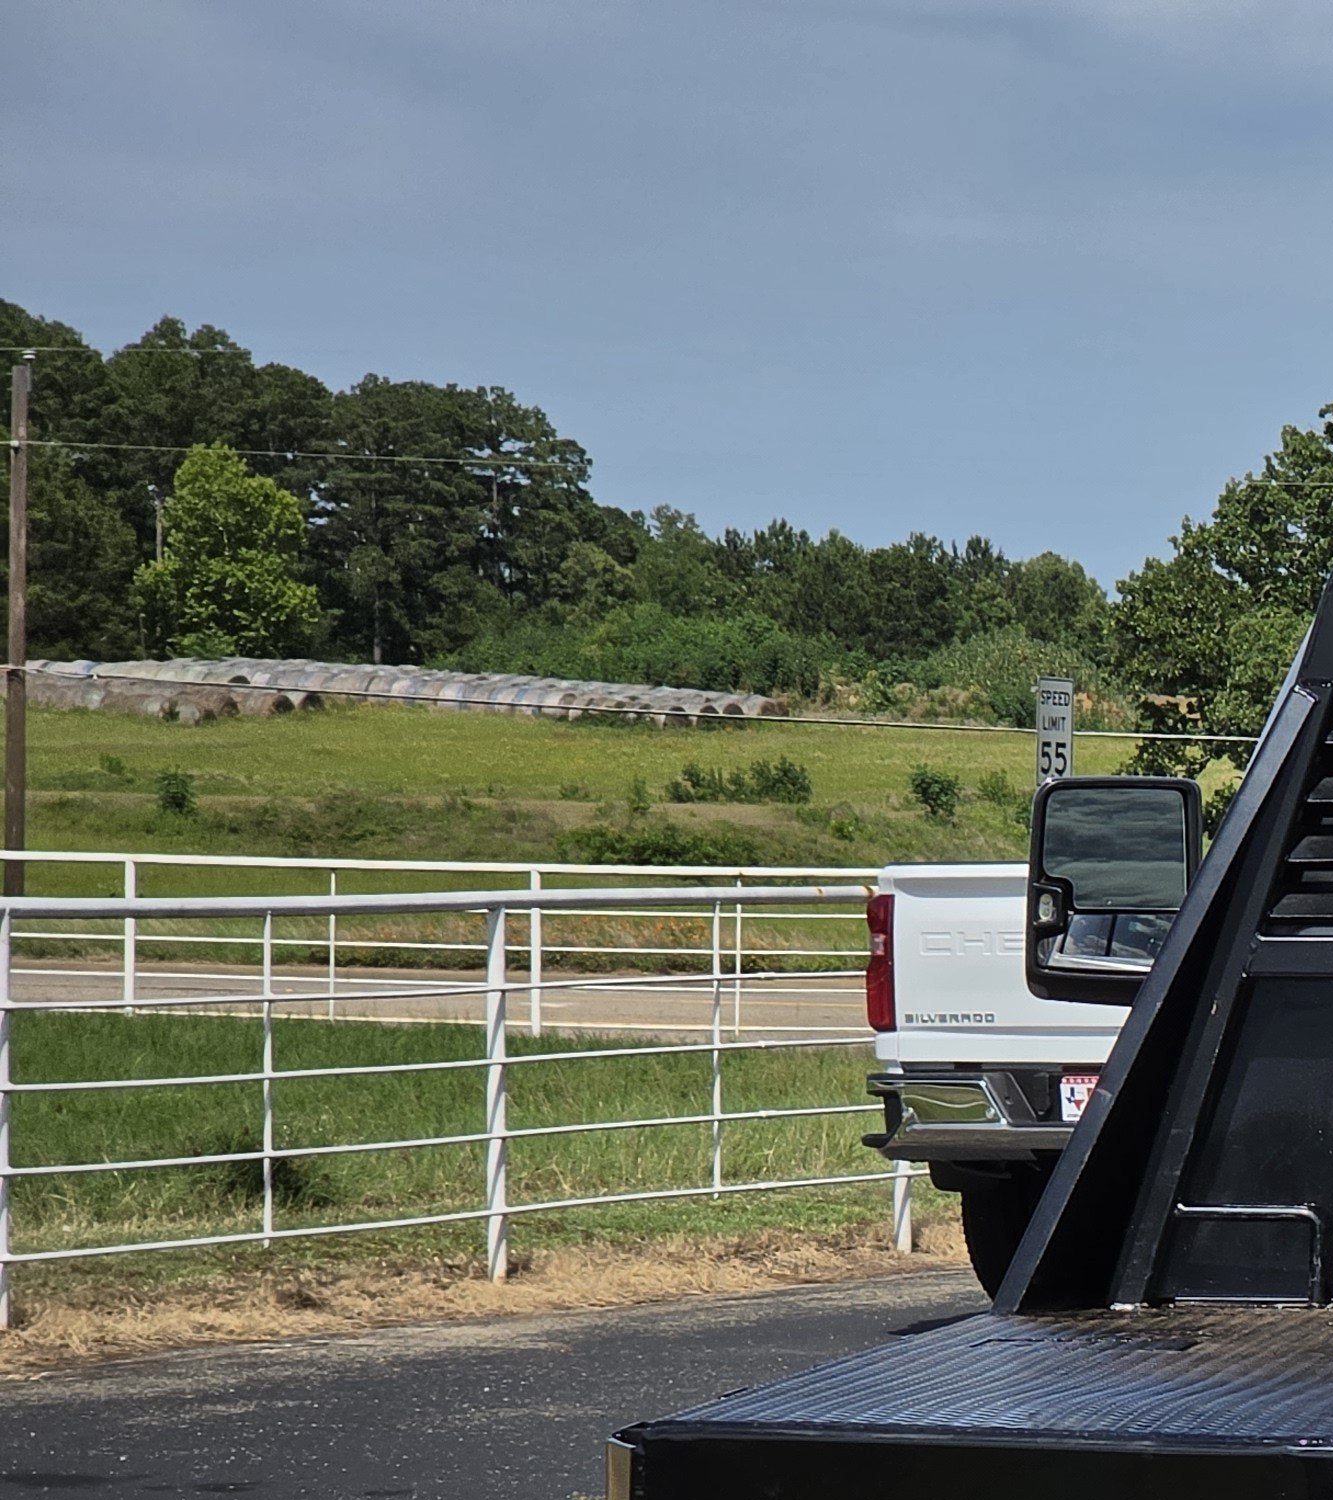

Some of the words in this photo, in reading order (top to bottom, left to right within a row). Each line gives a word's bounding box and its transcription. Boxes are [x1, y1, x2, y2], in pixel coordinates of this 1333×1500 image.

[1041, 690, 1070, 707] SPEED
[1042, 715, 1066, 731] LIMIT
[1041, 741, 1067, 776] 55
[904, 1013, 995, 1024] SILVERADO
